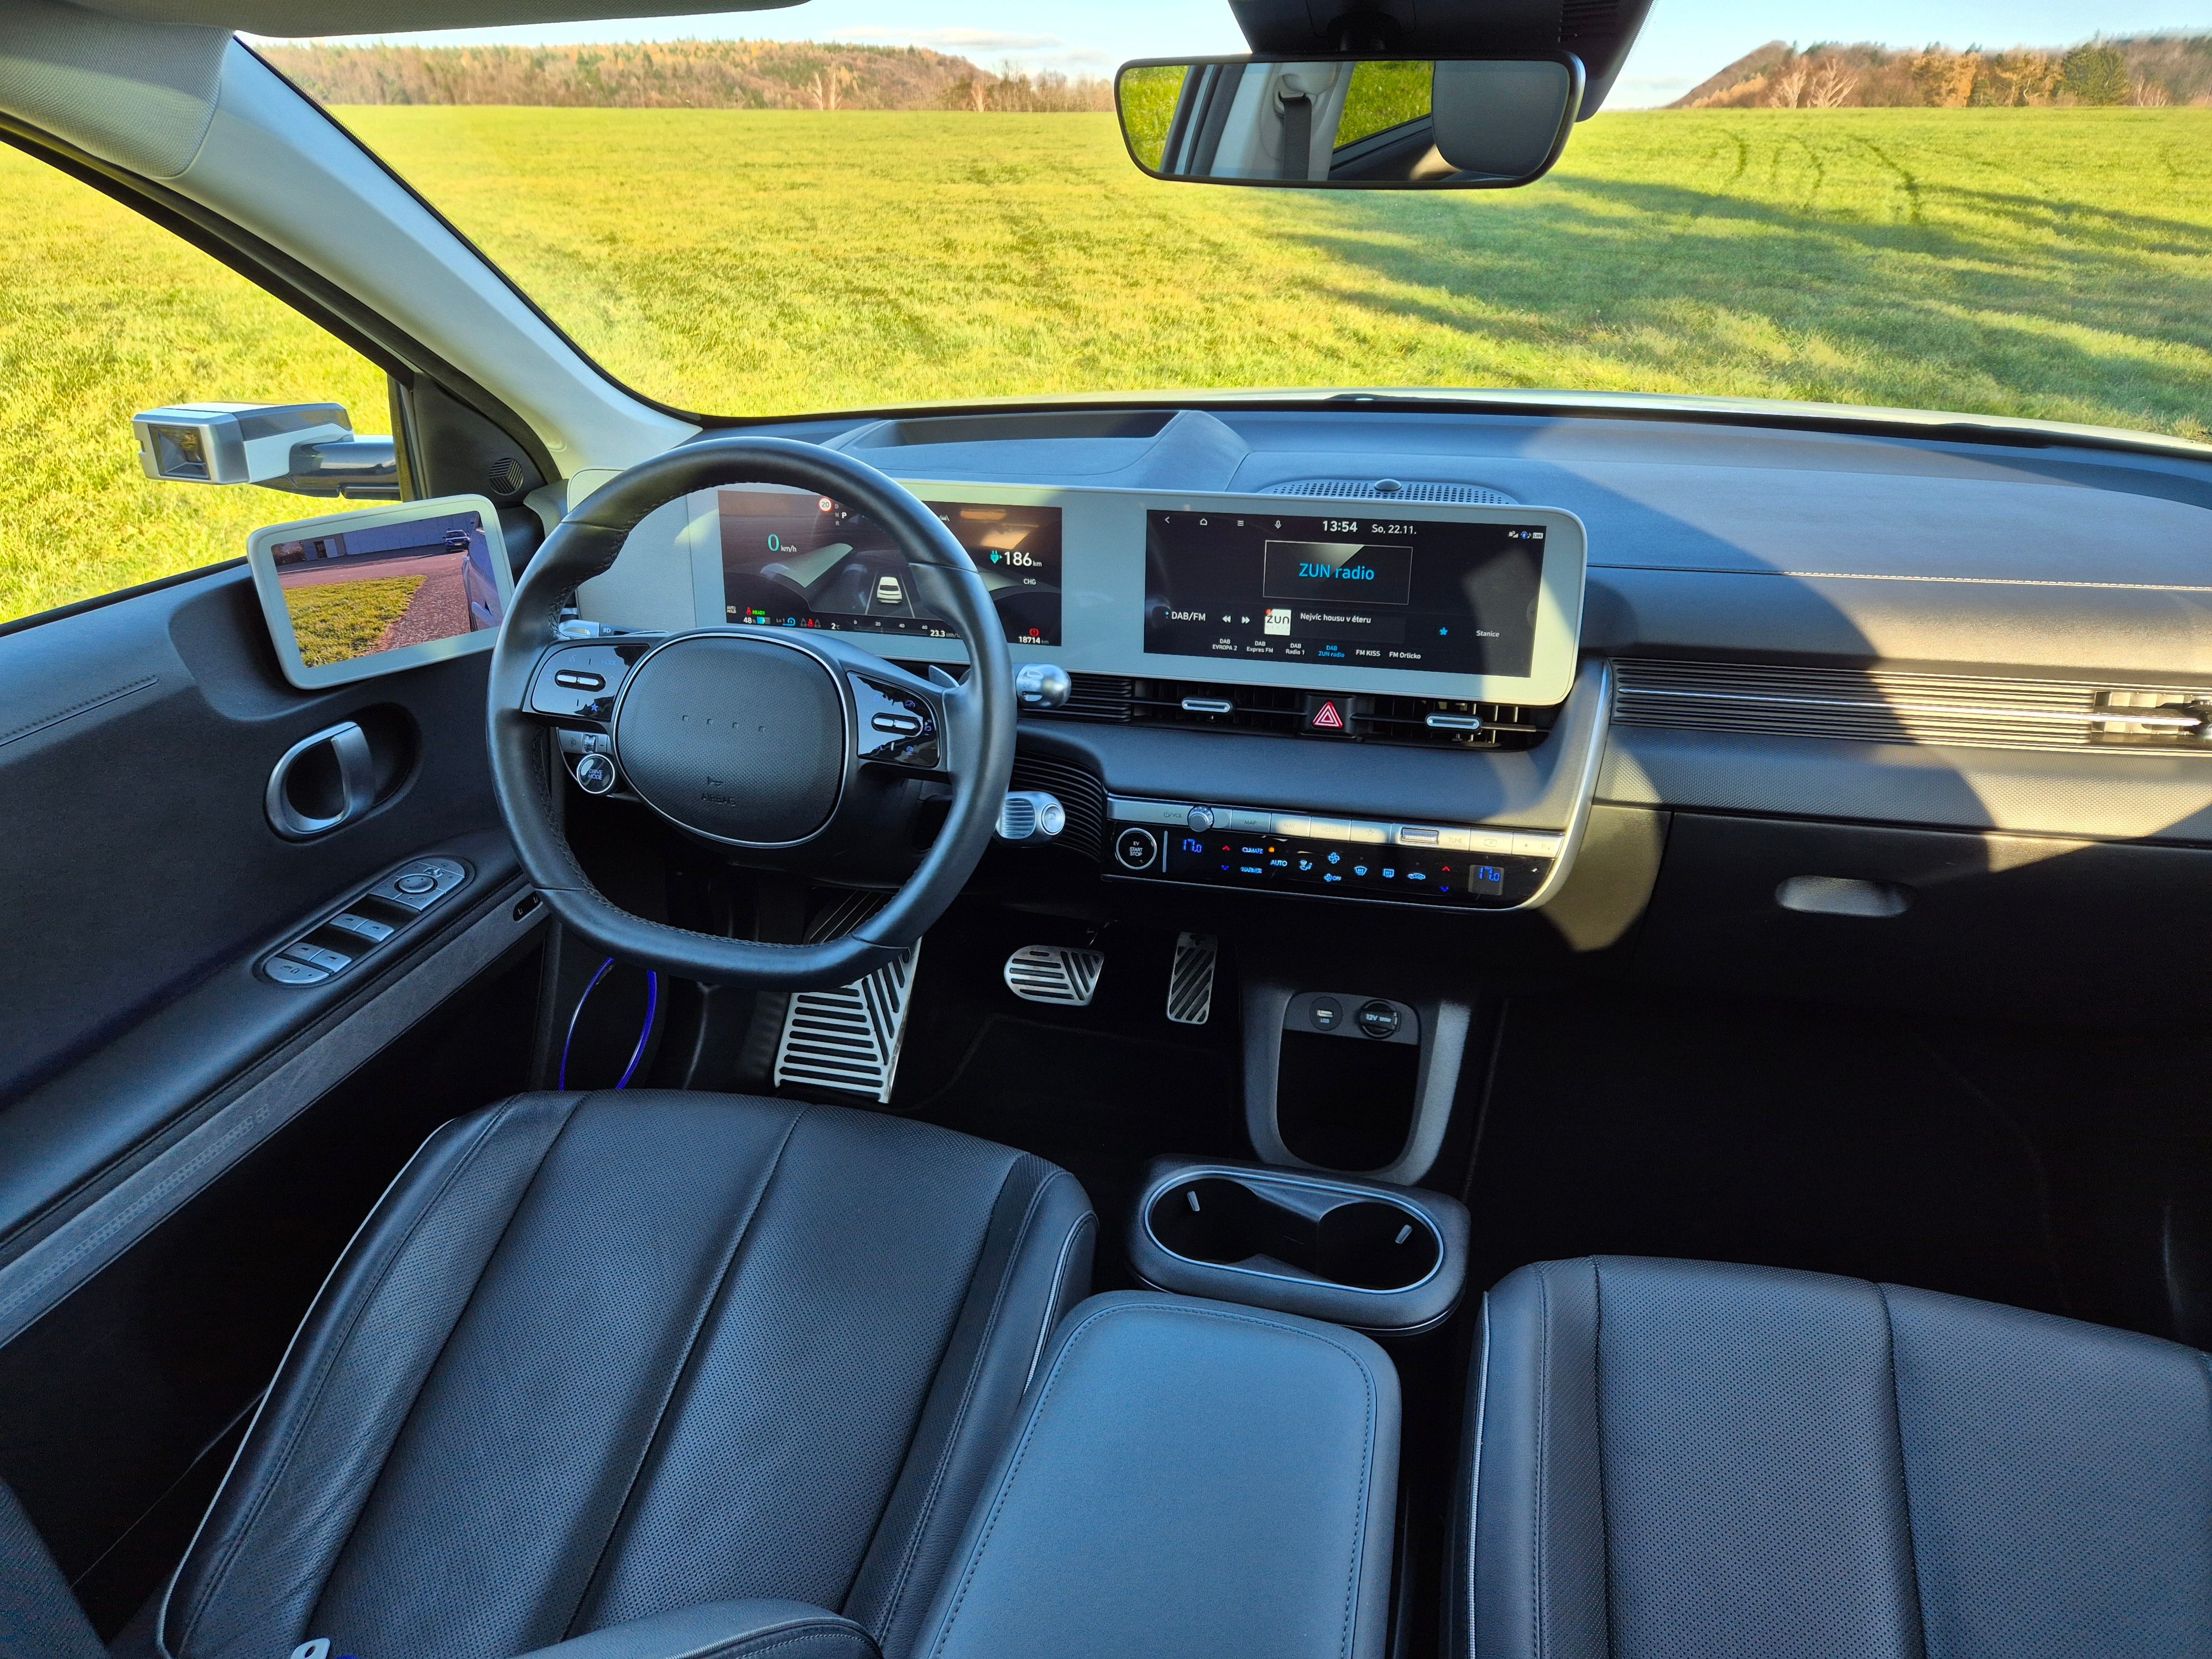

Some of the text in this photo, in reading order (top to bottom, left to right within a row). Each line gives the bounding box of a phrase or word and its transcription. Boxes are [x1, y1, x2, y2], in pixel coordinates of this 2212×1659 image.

[1322, 520, 1358, 533] 13:54
[1388, 525, 1417, 535] 22.11.
[768, 534, 780, 551] 0
[1004, 551, 1032, 566] 186
[1299, 563, 1375, 581] ZUN radio
[1171, 611, 1206, 622] DAB/FM
[1300, 612, 1322, 621] Nejvíc
[1323, 613, 1345, 622] housu
[1352, 615, 1371, 624] éteru
[930, 629, 946, 638] 23.3
[1018, 636, 1041, 644] 18714
[1182, 838, 1202, 853] 17.0
[1241, 846, 1264, 854] CLIMATE
[1479, 867, 1500, 881] 17.0
